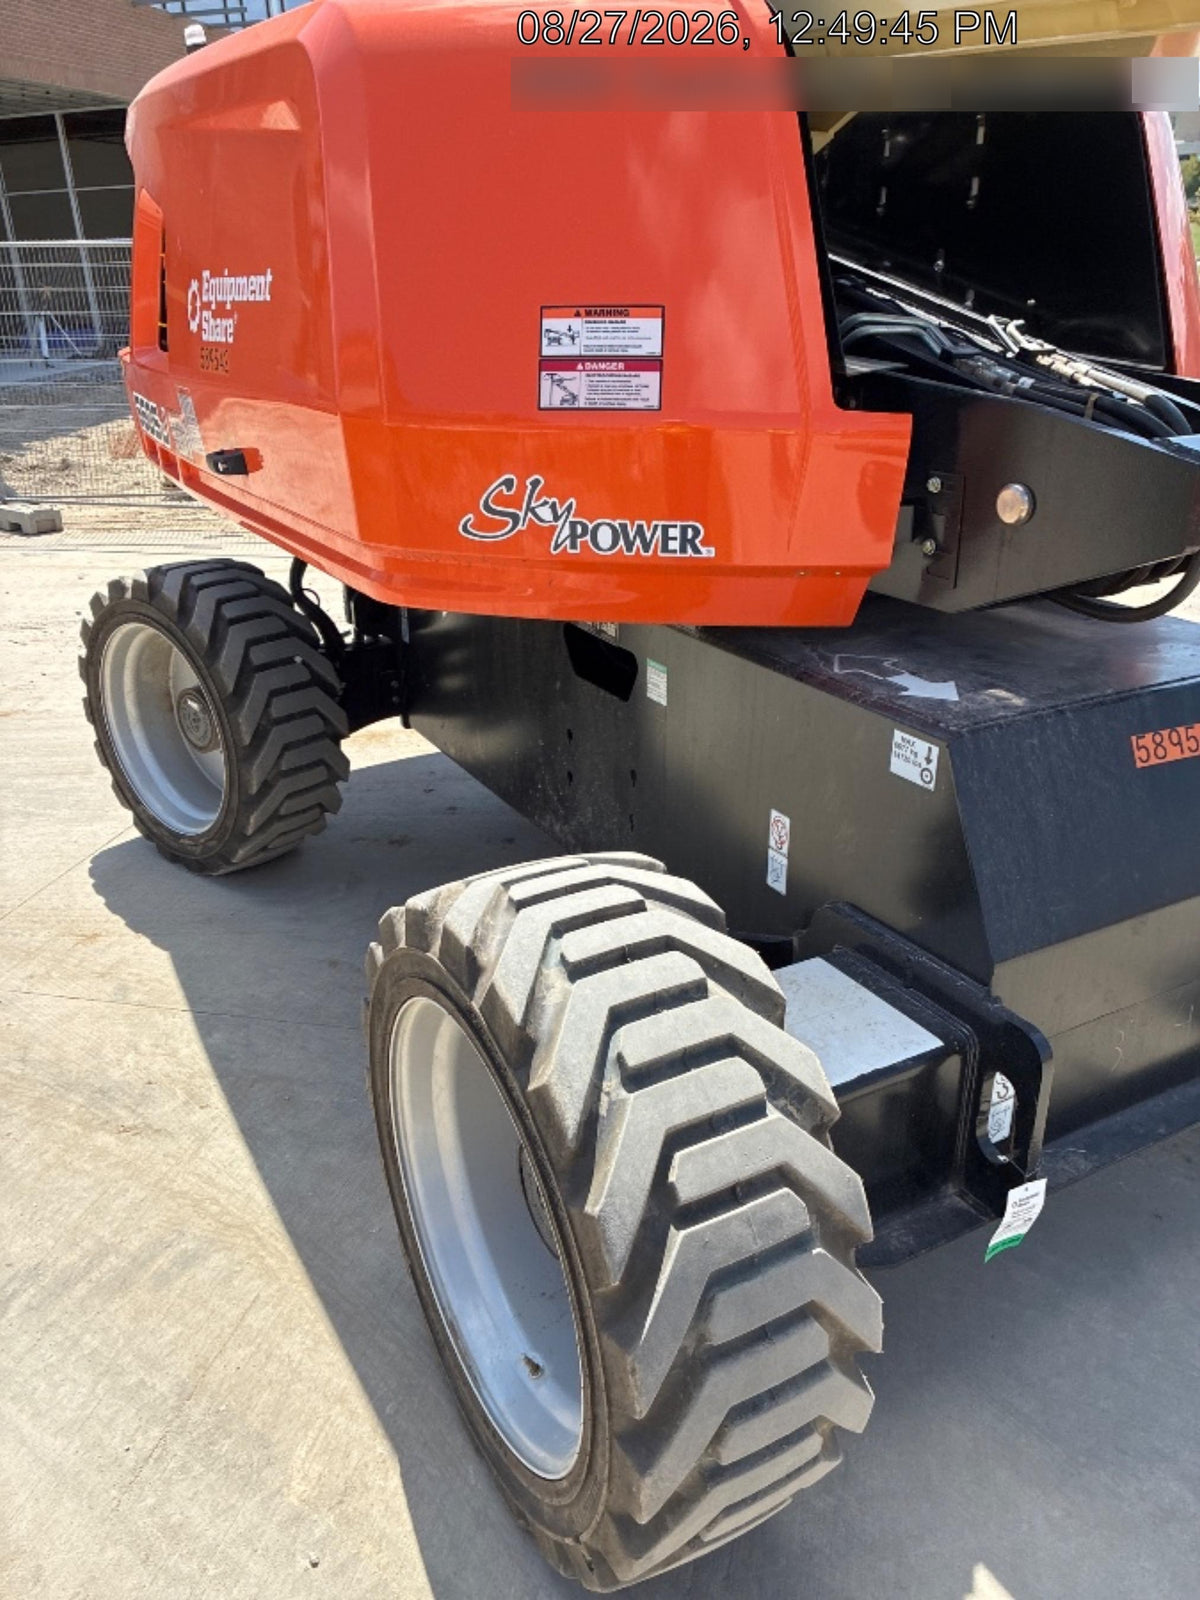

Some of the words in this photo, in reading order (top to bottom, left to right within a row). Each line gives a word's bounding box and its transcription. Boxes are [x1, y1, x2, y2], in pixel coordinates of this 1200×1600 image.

[201, 268, 273, 309] Equipment
[201, 310, 235, 344] Share
[584, 309, 630, 317] WARNING
[584, 362, 625, 371] DANGER
[458, 474, 576, 554] Sky
[566, 519, 704, 556] POWER
[1135, 726, 1200, 763] 5895
